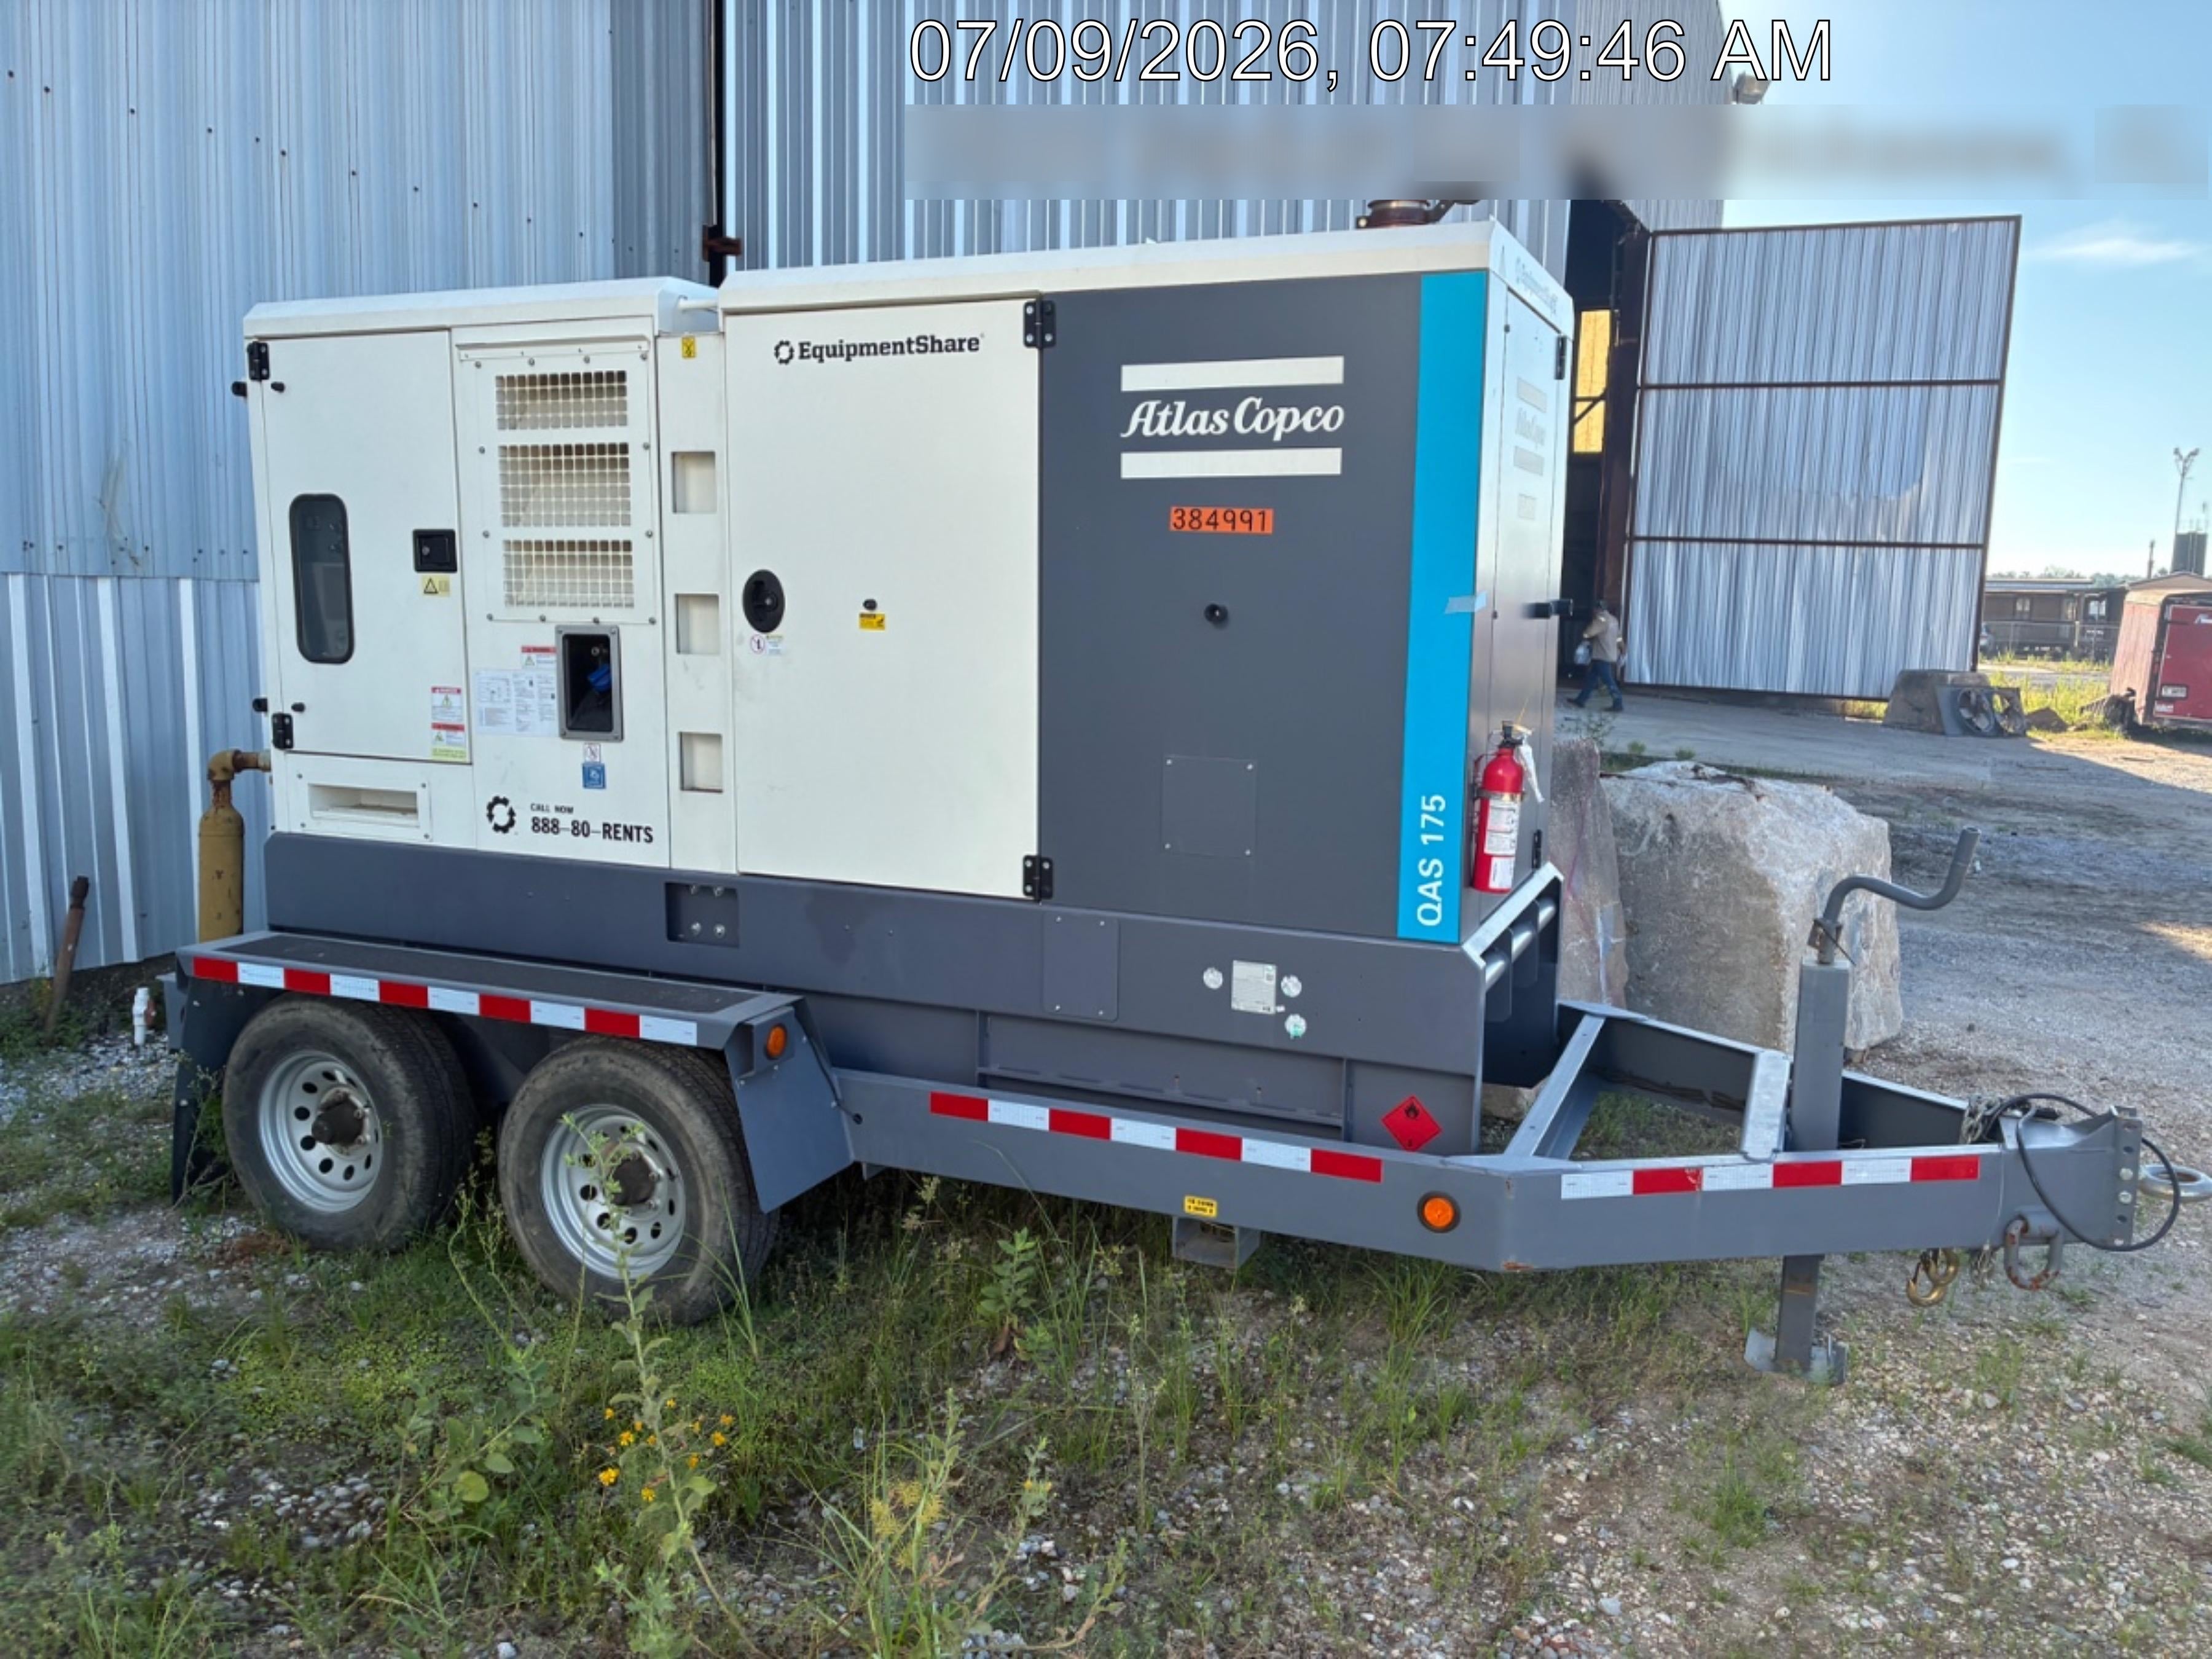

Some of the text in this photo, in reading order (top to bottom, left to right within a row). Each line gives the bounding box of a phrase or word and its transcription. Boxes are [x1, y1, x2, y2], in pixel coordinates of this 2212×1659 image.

[798, 334, 981, 364] EquipmentShare
[1120, 395, 1345, 442] Atlas Copco
[1172, 508, 1268, 532] 384991
[530, 802, 574, 814] CALL NOW
[1416, 794, 1446, 927] QAS 175
